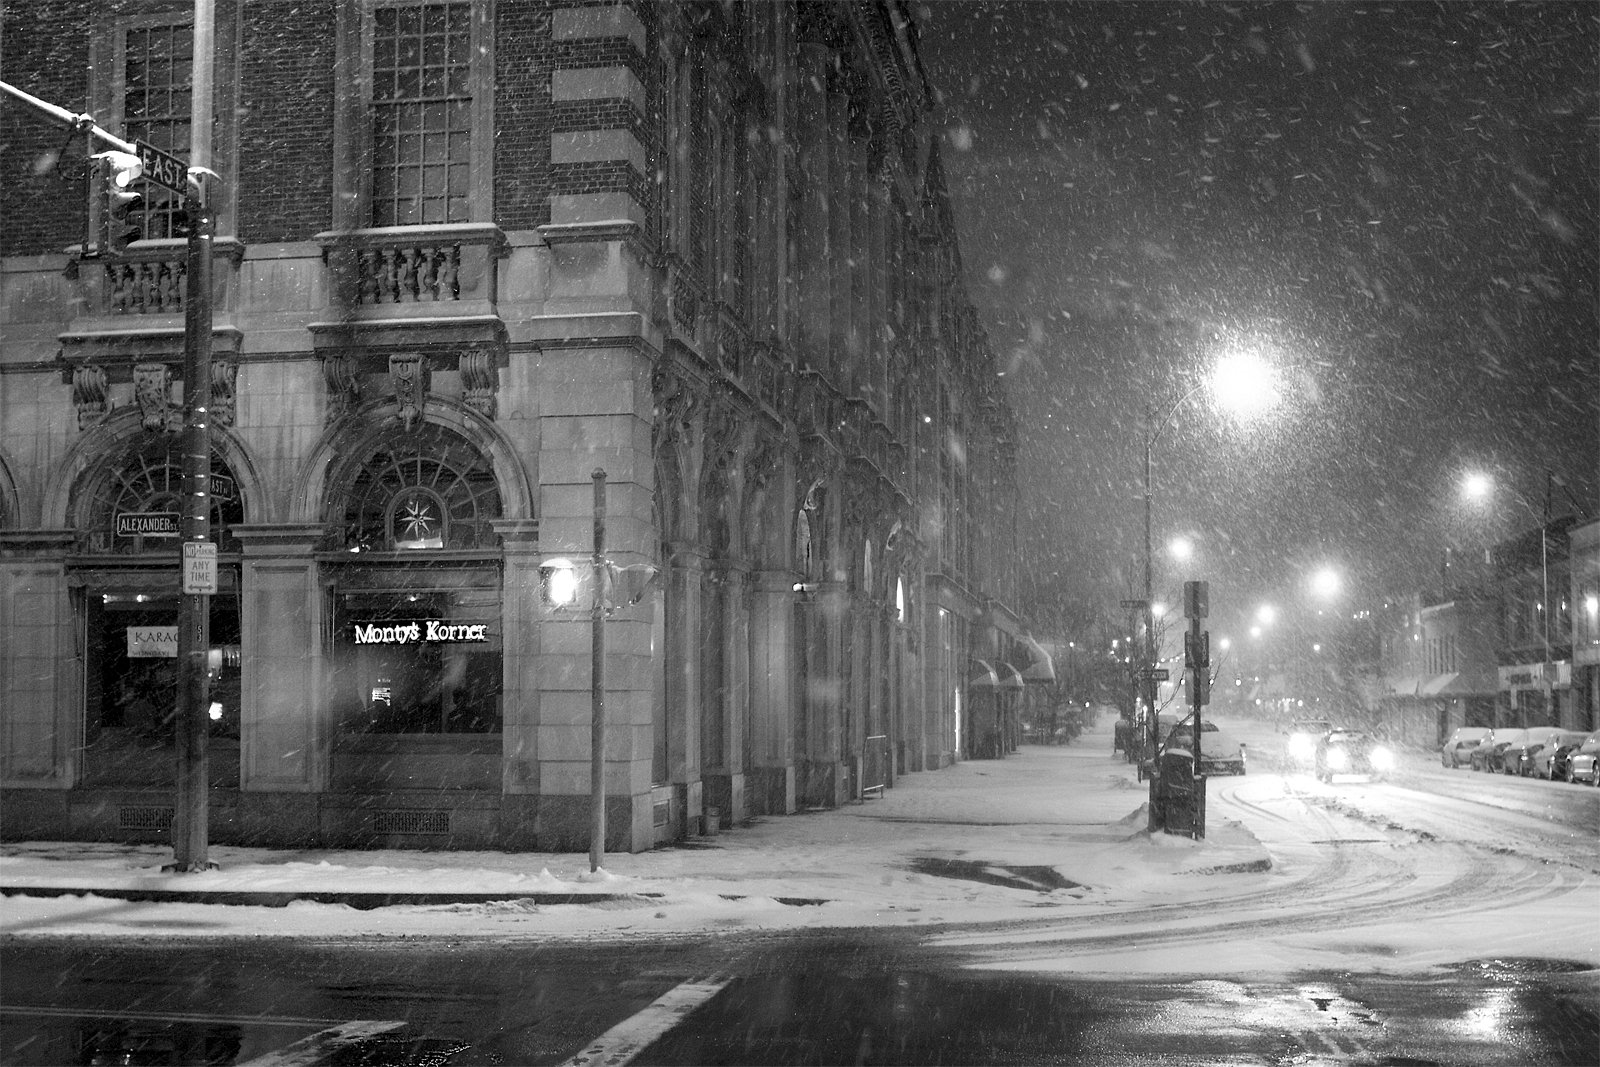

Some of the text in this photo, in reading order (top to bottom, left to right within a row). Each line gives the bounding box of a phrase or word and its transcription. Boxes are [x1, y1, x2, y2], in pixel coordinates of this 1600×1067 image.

[143, 148, 182, 189] EAST
[120, 517, 170, 531] ALEXANDER
[185, 545, 195, 557] NO
[192, 561, 210, 570] ANY
[190, 572, 211, 582] TIME
[354, 621, 487, 644] Monty's Korner
